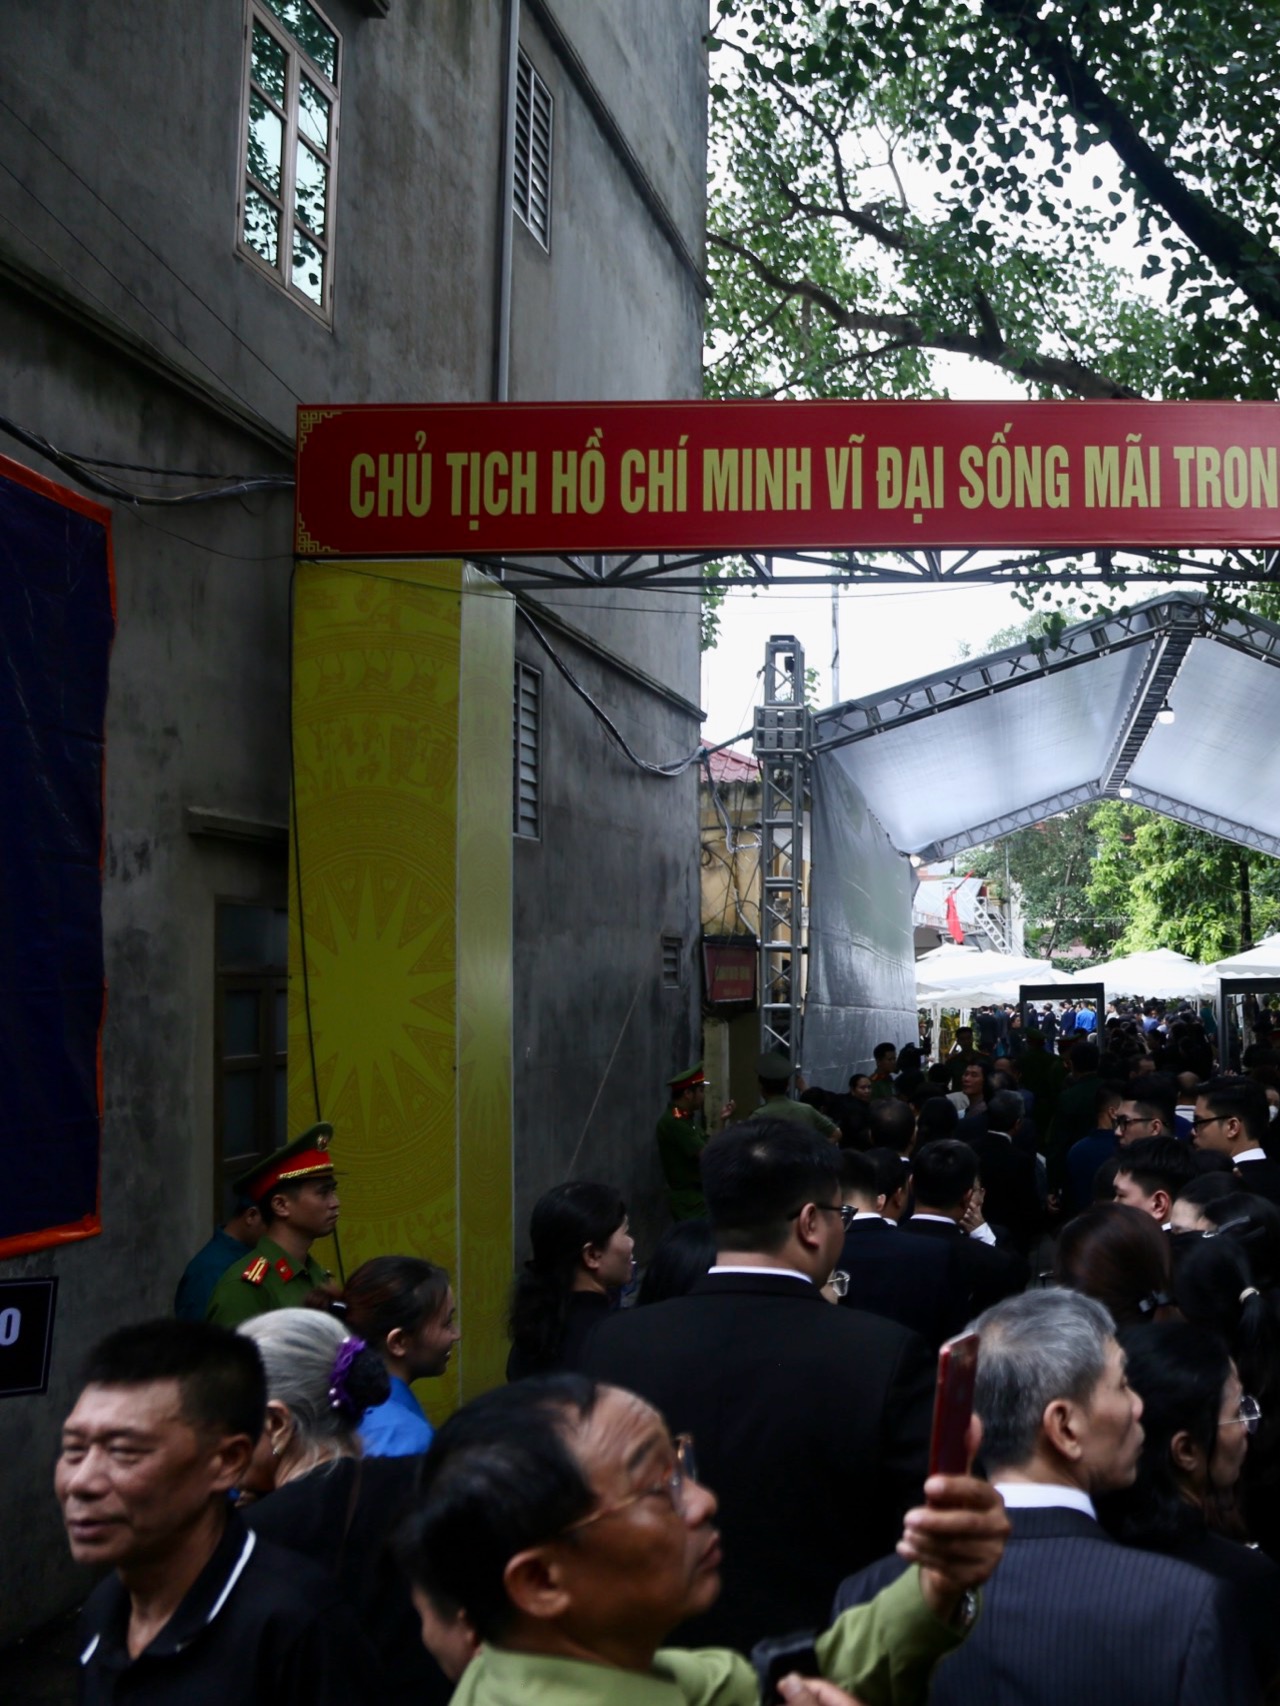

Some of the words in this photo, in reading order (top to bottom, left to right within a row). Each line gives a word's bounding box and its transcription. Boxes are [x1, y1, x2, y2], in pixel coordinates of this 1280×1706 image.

[350, 430, 432, 517] CHỦ
[446, 451, 537, 530] TỊCH
[552, 428, 605, 514] HỒ
[620, 435, 689, 513] CHÍ
[703, 447, 812, 512] MINH
[825, 434, 865, 510] VĨ
[876, 446, 945, 524] ĐẠI
[959, 423, 1070, 509] SỐNG
[1084, 432, 1161, 508] MÃI
